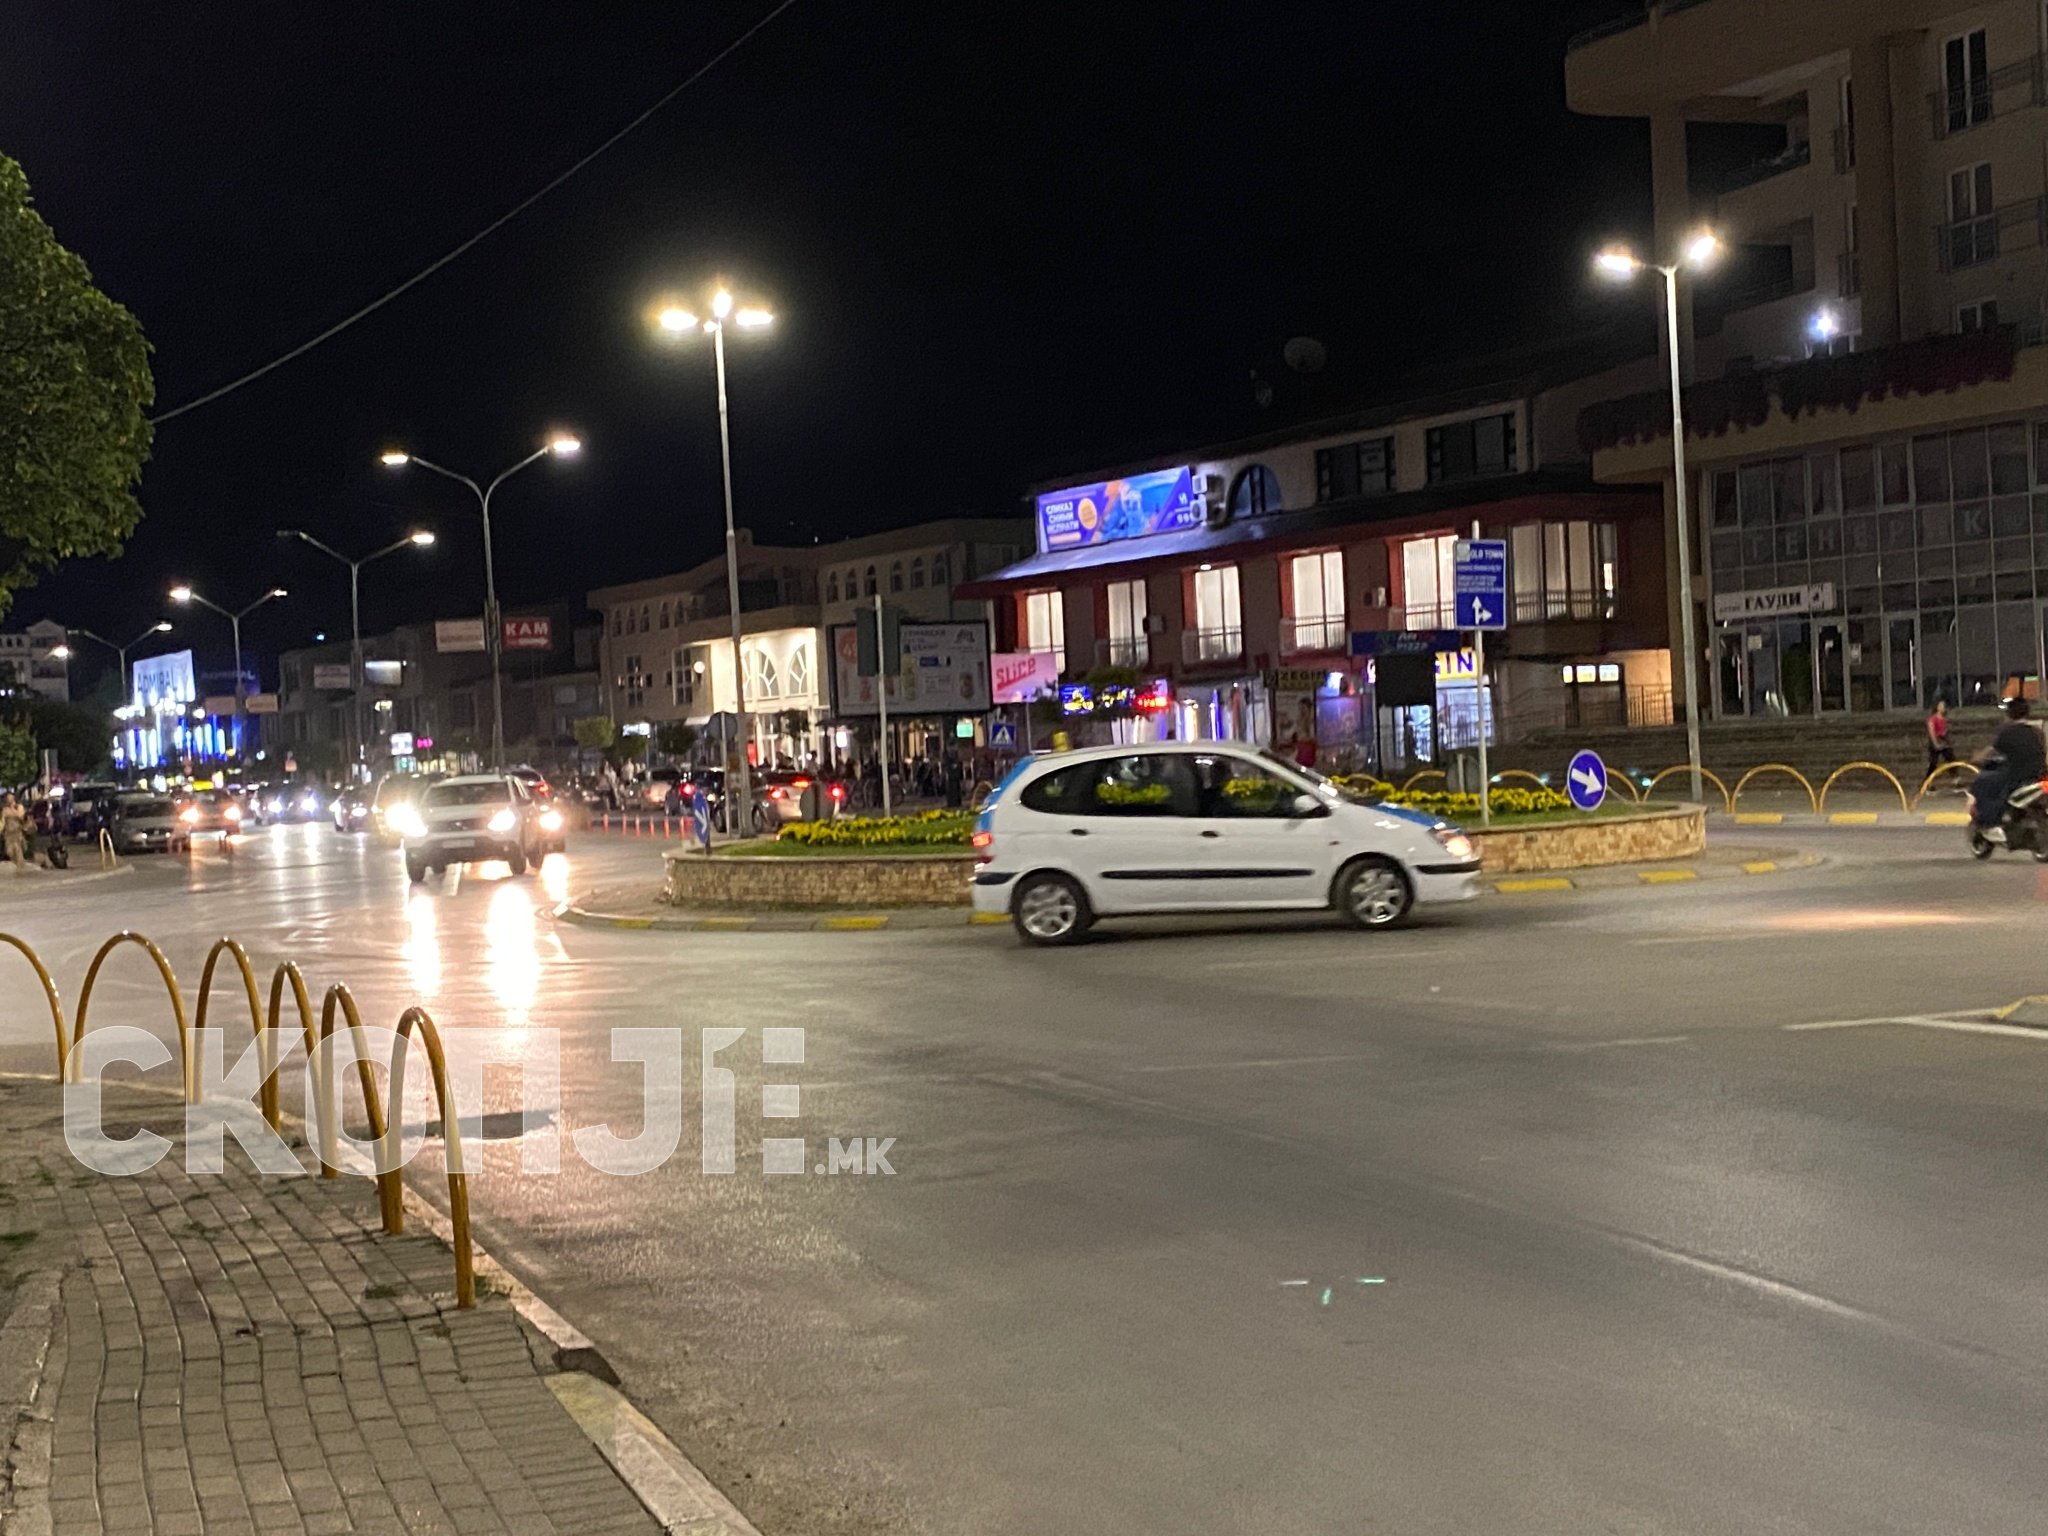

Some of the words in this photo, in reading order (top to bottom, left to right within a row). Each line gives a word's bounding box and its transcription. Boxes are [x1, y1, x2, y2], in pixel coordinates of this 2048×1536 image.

[1470, 549, 1484, 559] OLD
[1485, 549, 1504, 560] TOWN
[136, 665, 178, 694] ADMIRAL
